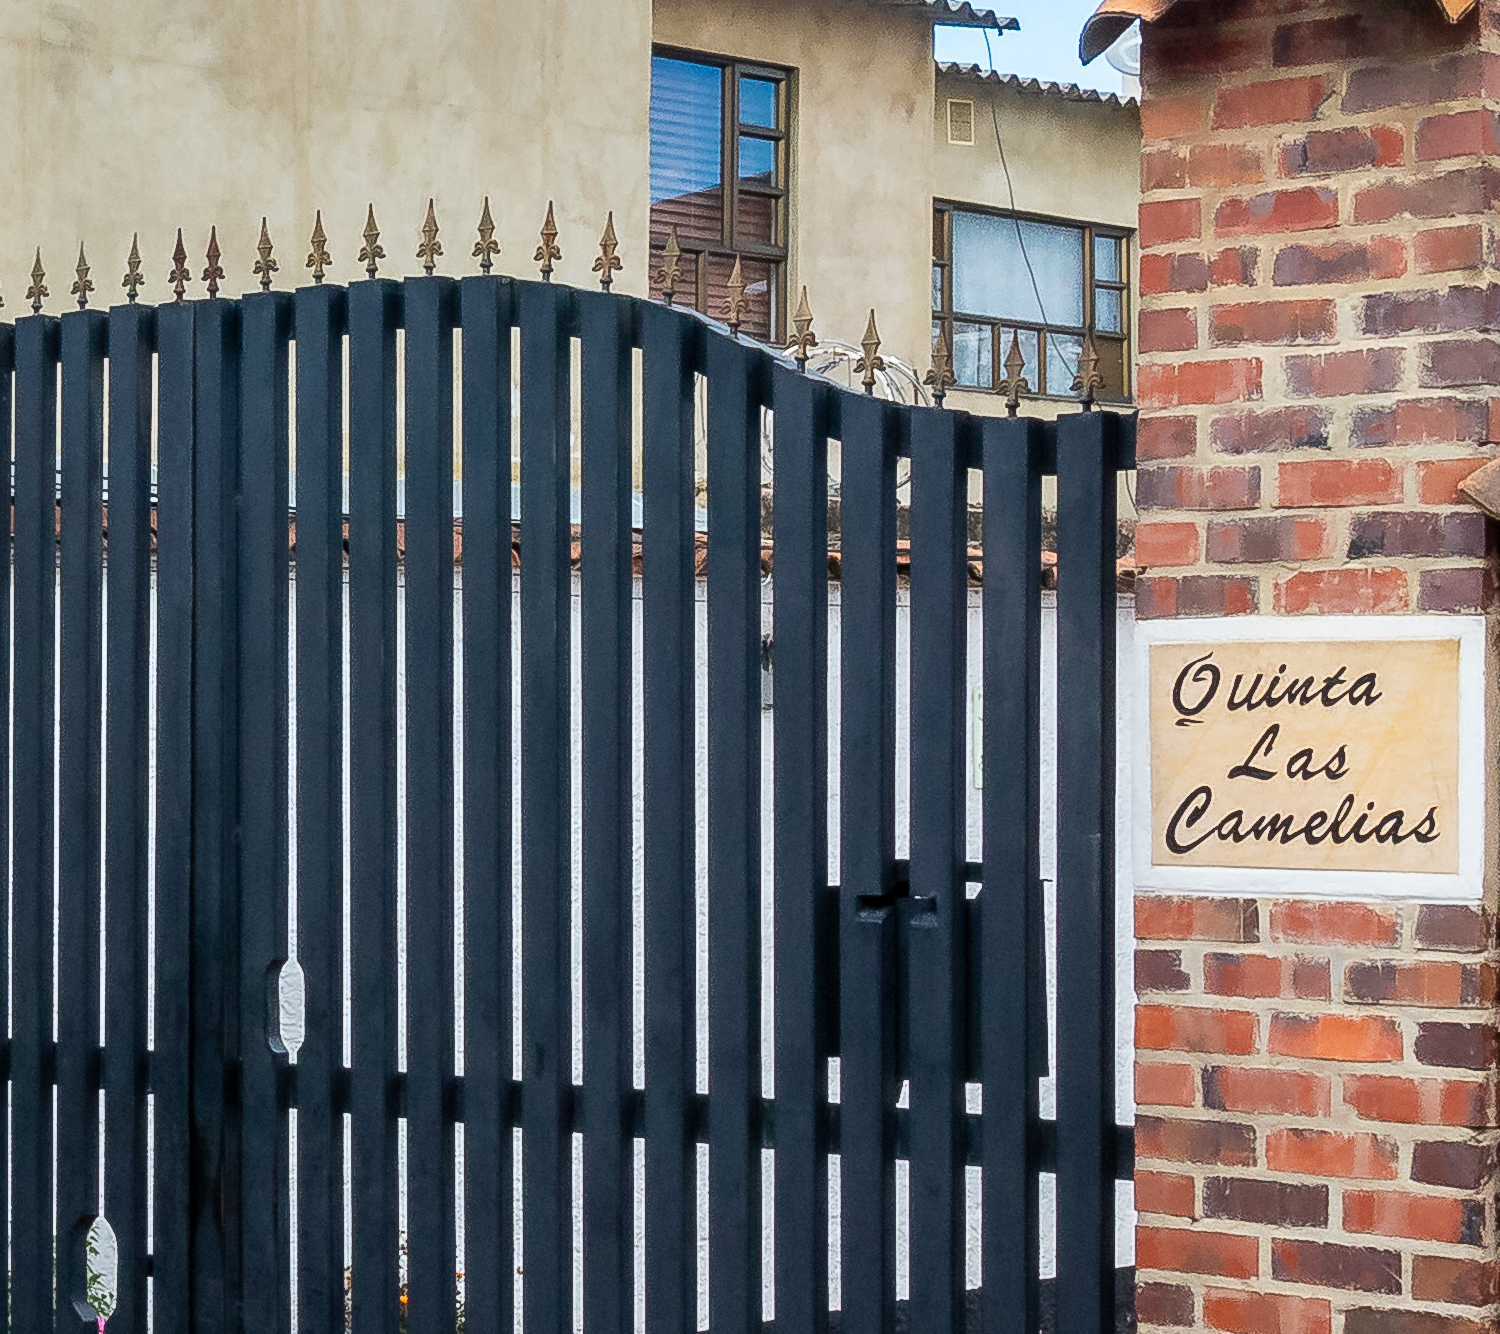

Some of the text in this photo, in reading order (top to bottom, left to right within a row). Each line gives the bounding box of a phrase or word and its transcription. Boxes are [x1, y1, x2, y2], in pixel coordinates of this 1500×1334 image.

[1172, 651, 1383, 727] Quinta
[1227, 723, 1351, 781] Las
[1165, 785, 1441, 855] Camelias
